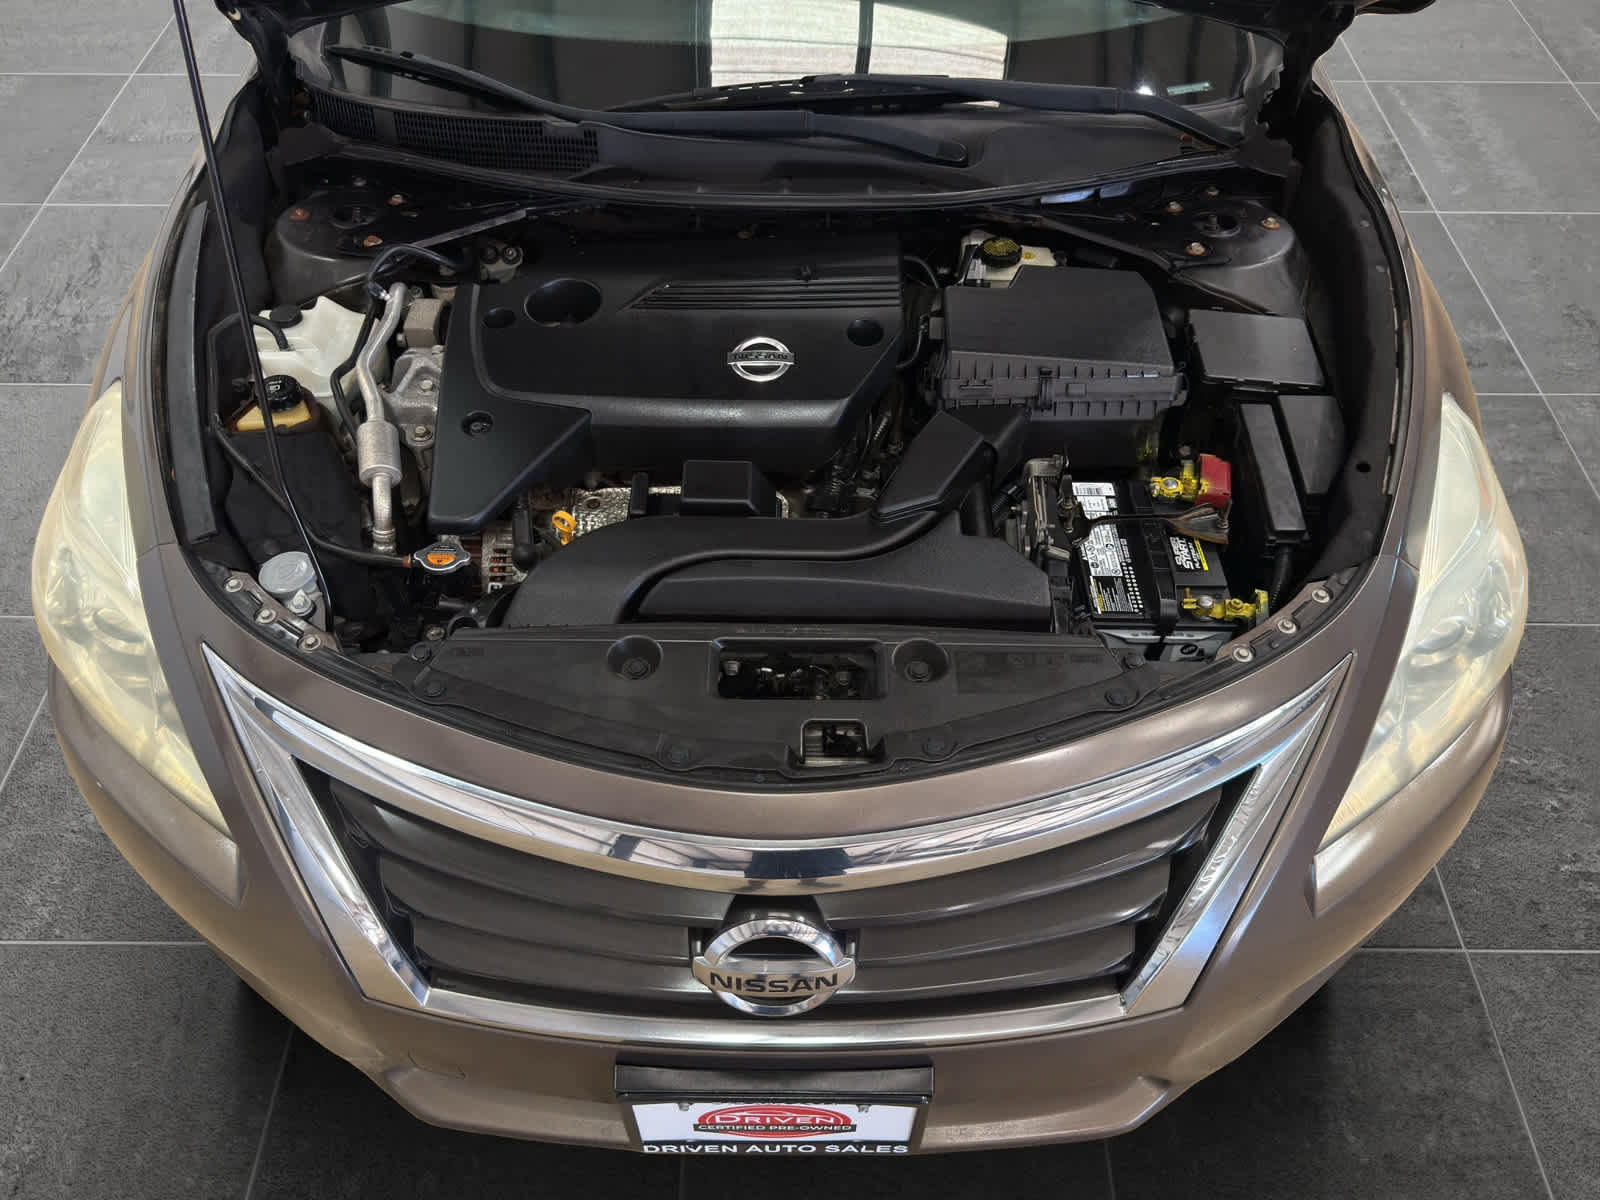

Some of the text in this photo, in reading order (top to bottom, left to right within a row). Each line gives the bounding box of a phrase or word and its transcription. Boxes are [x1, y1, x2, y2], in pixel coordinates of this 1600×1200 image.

[1178, 538, 1194, 569] START
[710, 972, 838, 993] NISSAN
[714, 1115, 835, 1124] DRIVEN
[643, 1144, 909, 1153] DRIVEN AUTO SALES
